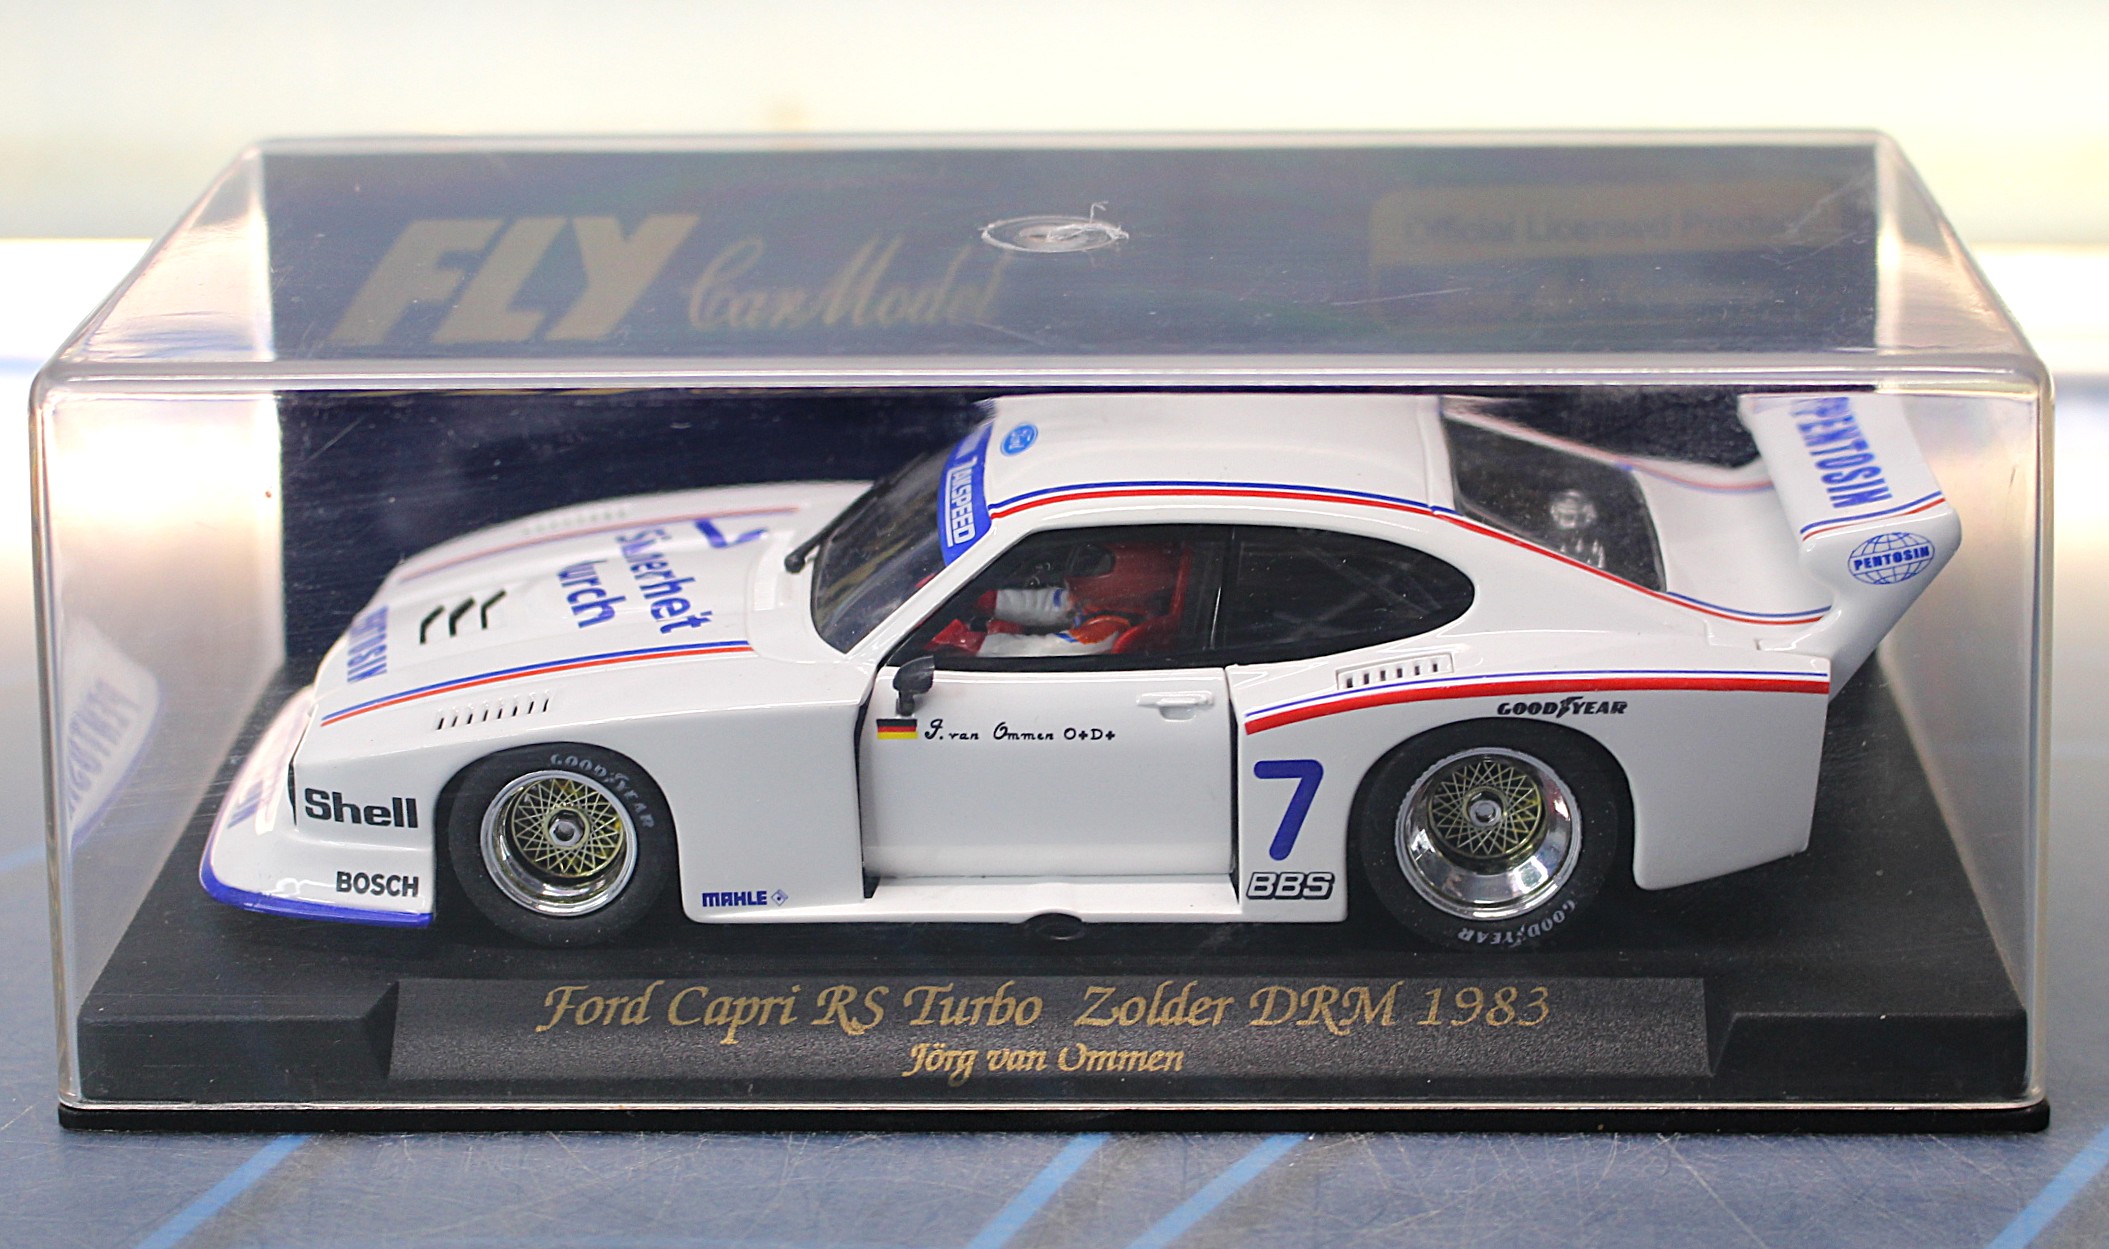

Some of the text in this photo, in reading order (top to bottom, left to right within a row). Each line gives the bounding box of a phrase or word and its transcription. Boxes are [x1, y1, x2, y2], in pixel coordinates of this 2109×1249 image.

[328, 213, 700, 347] FLY
[1852, 545, 1931, 572] PENTOSIN
[1497, 696, 1628, 719] GOODYEAR
[993, 721, 1055, 741] Ommen
[304, 787, 418, 829] Shell
[549, 753, 655, 829] GOODYEAR
[1253, 758, 1324, 861] 7
[335, 871, 419, 898] BOSCH
[702, 890, 768, 907] MAHLE
[1245, 871, 1336, 900] BBS
[1457, 898, 1577, 949] GOODYEAR
[535, 979, 1552, 1045] Ford Capri RS Turbo Zolder DRM 1983
[902, 1042, 1185, 1088] Jörg van Ommen
